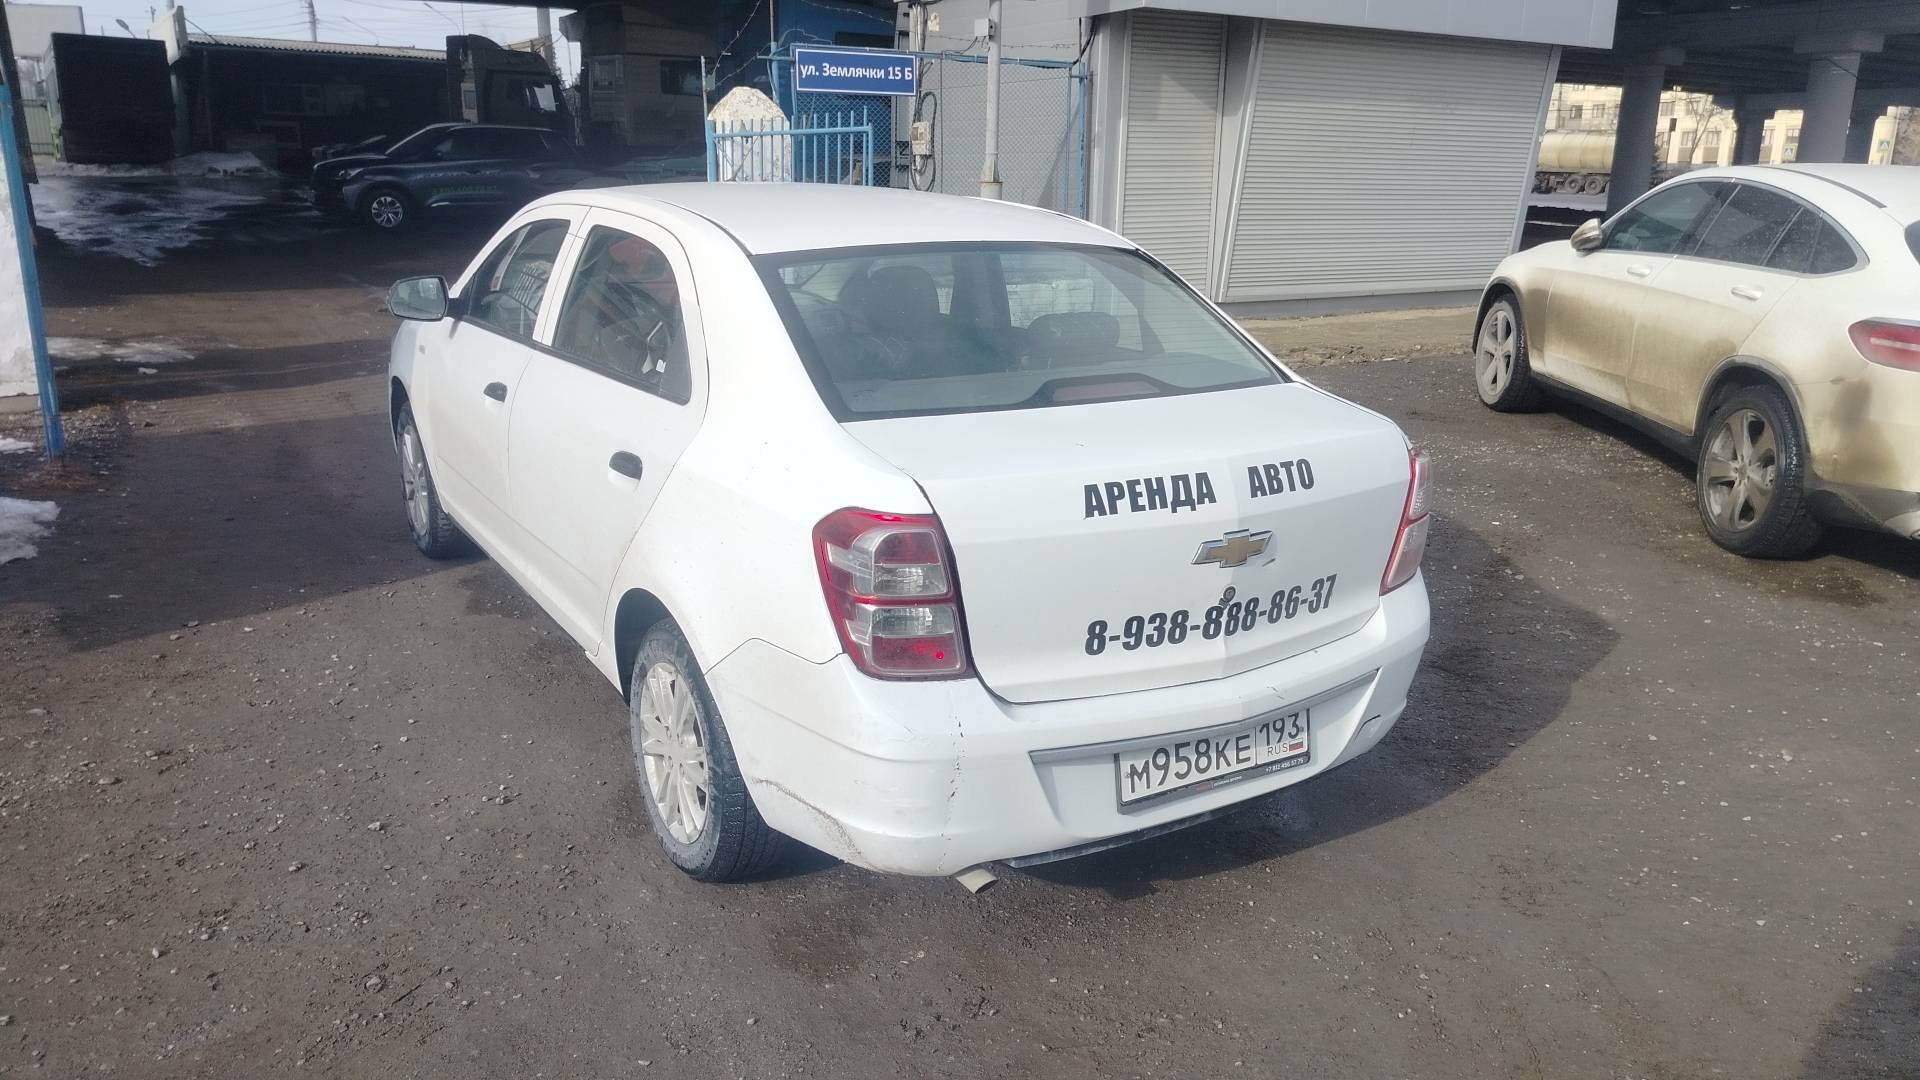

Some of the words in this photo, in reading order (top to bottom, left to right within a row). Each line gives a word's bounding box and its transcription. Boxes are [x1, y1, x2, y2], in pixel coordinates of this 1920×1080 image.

[800, 63, 820, 78] ул.
[822, 63, 885, 79] Землячки
[887, 67, 902, 80] 15
[904, 67, 913, 80] Б
[1084, 471, 1217, 518] АРЕНДА
[1247, 458, 1315, 499] АВТО
[1084, 573, 1338, 656] 8-938-888-86-37
[1129, 733, 1251, 794] М958КЕ
[1258, 712, 1300, 746] 193
[1267, 742, 1288, 757] RUS
